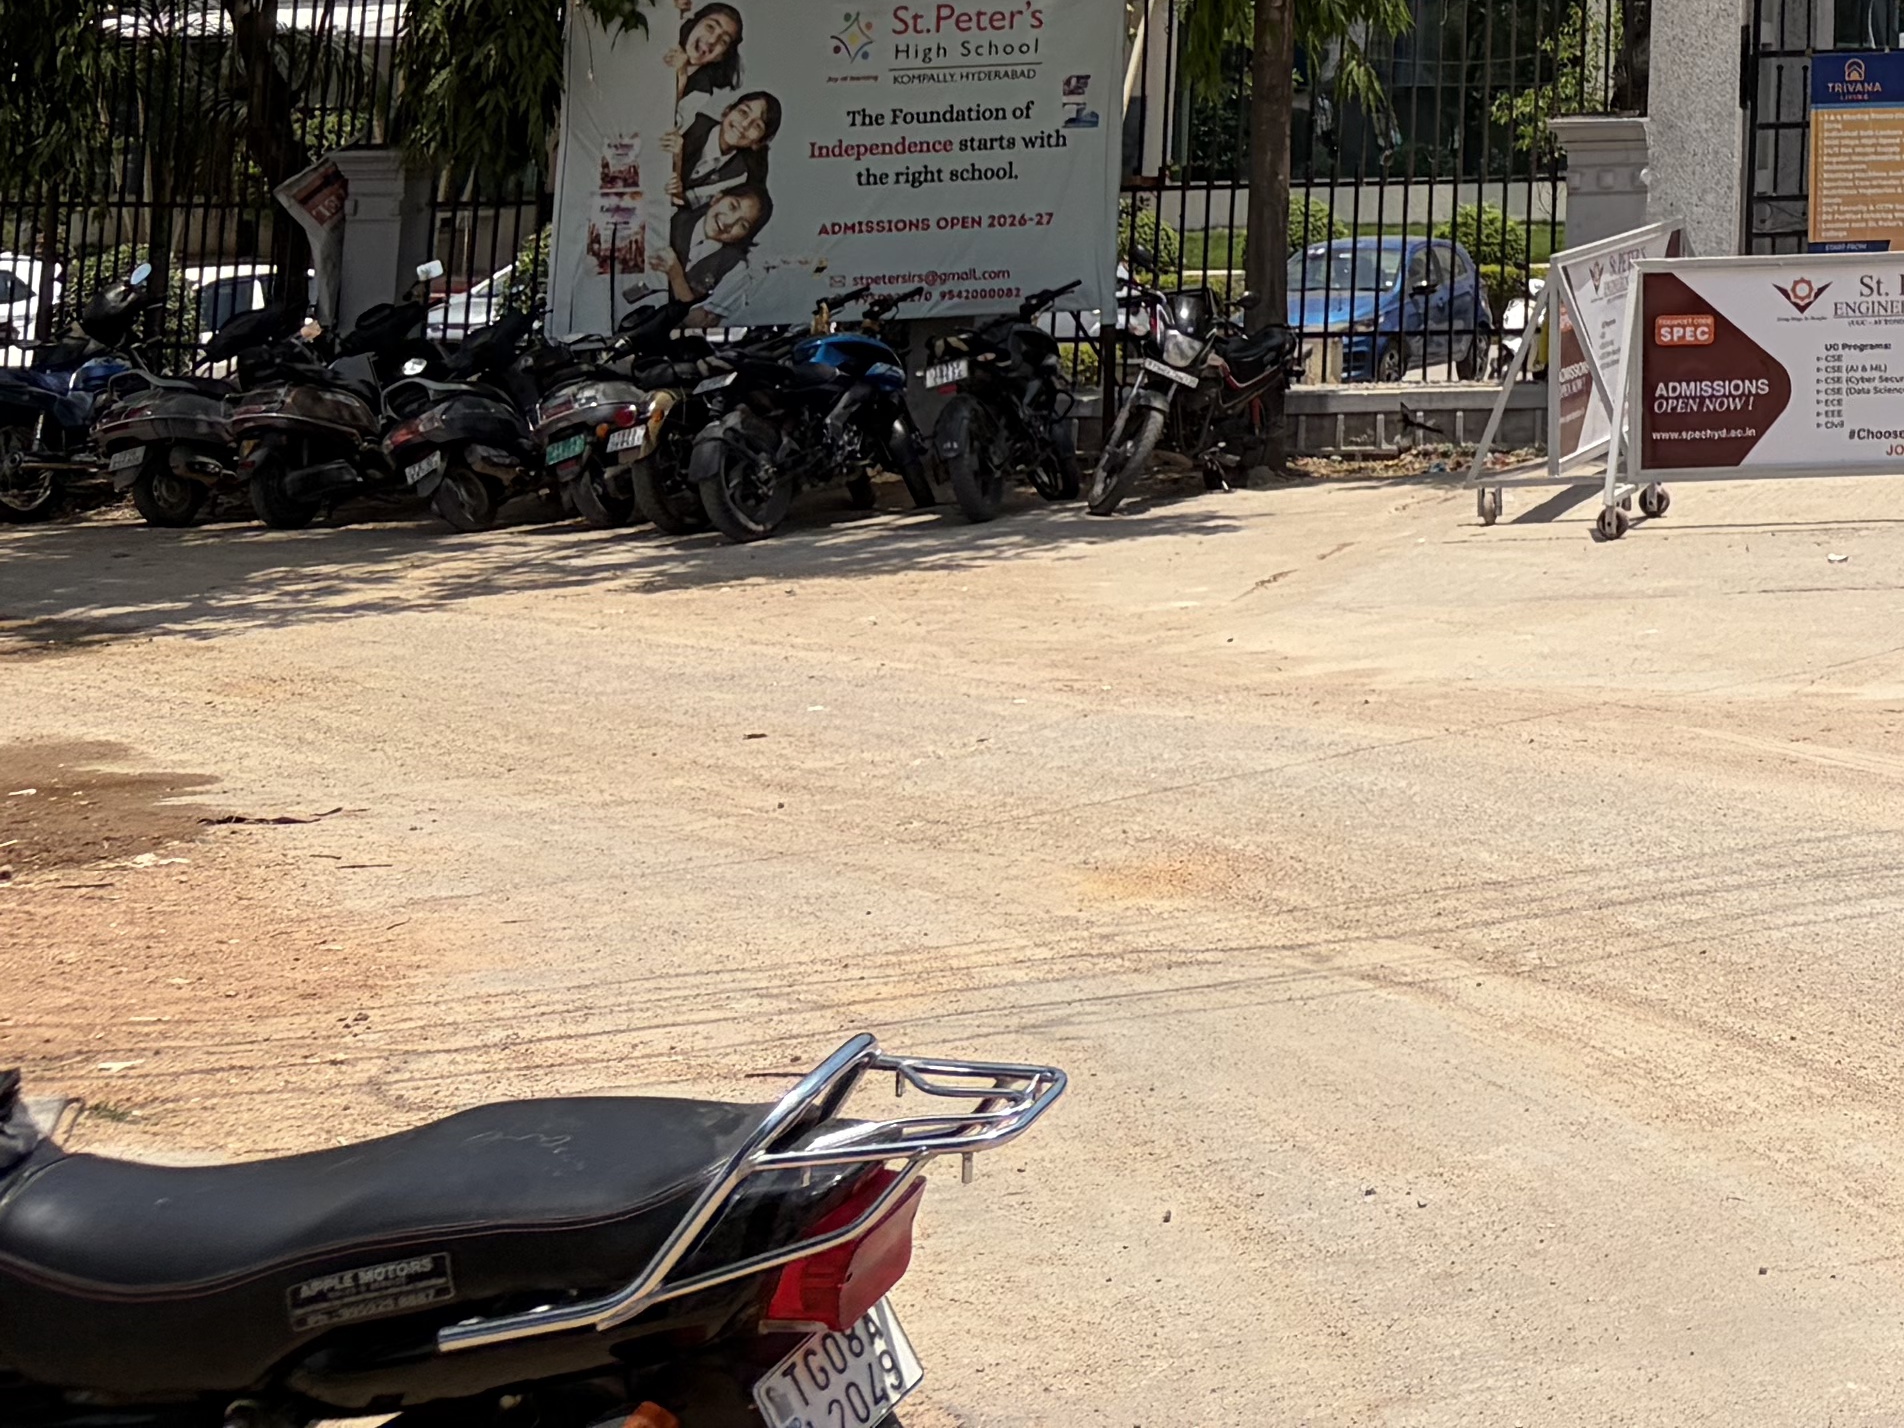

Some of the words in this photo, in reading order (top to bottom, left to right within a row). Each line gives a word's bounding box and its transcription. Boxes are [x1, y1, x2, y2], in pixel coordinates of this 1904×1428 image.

[894, 43, 947, 64] High
[960, 38, 1039, 57] School
[960, 69, 1036, 82] HYDERABAD
[847, 110, 884, 127] The
[890, 104, 1006, 125] Foundation
[1012, 101, 1035, 119] of
[809, 136, 953, 161] Independence
[958, 133, 1015, 152] starts
[1022, 129, 1067, 148] with
[857, 168, 888, 186] the
[893, 166, 943, 188] right
[949, 162, 1018, 183] school.
[818, 218, 930, 236] ADMISSIONS
[936, 216, 982, 231] OPEN
[988, 212, 1053, 228] 2026-27
[1860, 274, 1889, 298] St.
[1660, 327, 1709, 341] SPEC
[1655, 379, 1769, 397] ADMISSIONS
[1825, 387, 1843, 395] CSE
[1654, 398, 1699, 413] OPEN
[1703, 397, 1745, 412] NOW
[300, 1273, 354, 1298] APPLE
[358, 1257, 433, 1283] MOTORS
